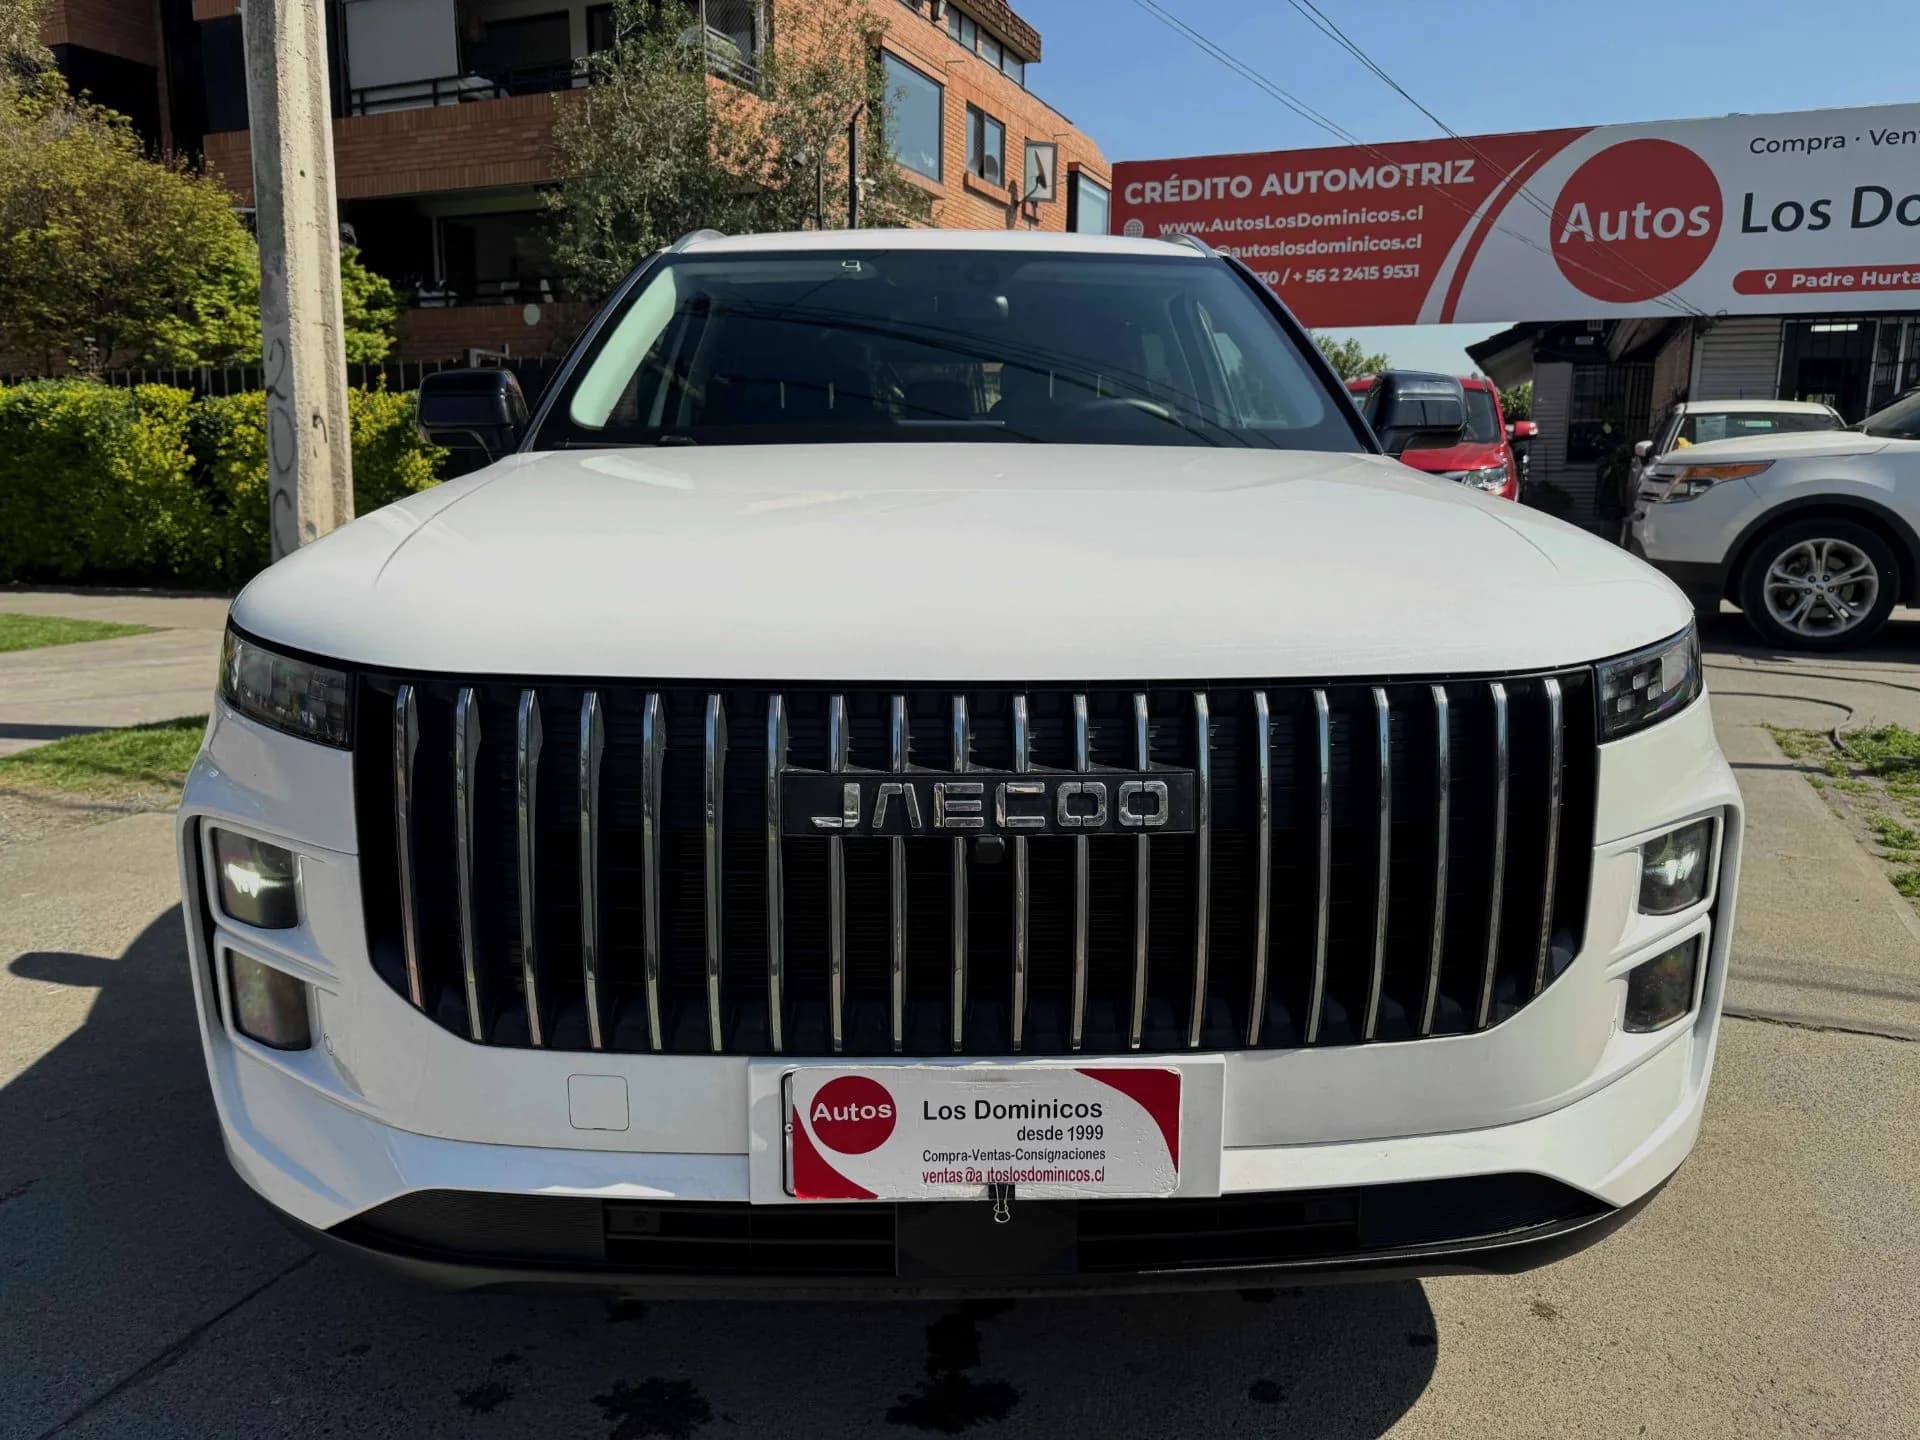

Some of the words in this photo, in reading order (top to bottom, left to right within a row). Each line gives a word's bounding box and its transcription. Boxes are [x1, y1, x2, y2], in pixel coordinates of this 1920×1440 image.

[1749, 133, 1846, 156] Compra
[1869, 128, 1920, 146] Ven
[1124, 173, 1253, 205] CRÉDITO
[1260, 159, 1475, 197] AUTOMOTRIZ
[1159, 205, 1424, 235] www.AutosLosDominicos.cl
[1559, 201, 1711, 244] Autos
[1741, 192, 1832, 234] Los
[1305, 268, 1326, 283] 56
[1329, 267, 1340, 282] 2
[1343, 265, 1379, 281] 2415
[1382, 264, 1420, 279] 9531
[1791, 272, 1854, 288] Padre
[811, 781, 1169, 828] JAECOO
[812, 1101, 892, 1122] Autos
[923, 1100, 965, 1121] Los
[974, 1098, 1103, 1120] Dominicos
[1017, 1125, 1064, 1142] desde
[1067, 1124, 1104, 1142] 1999
[922, 1148, 1106, 1164] Compra-Ventas-Consignaciones
